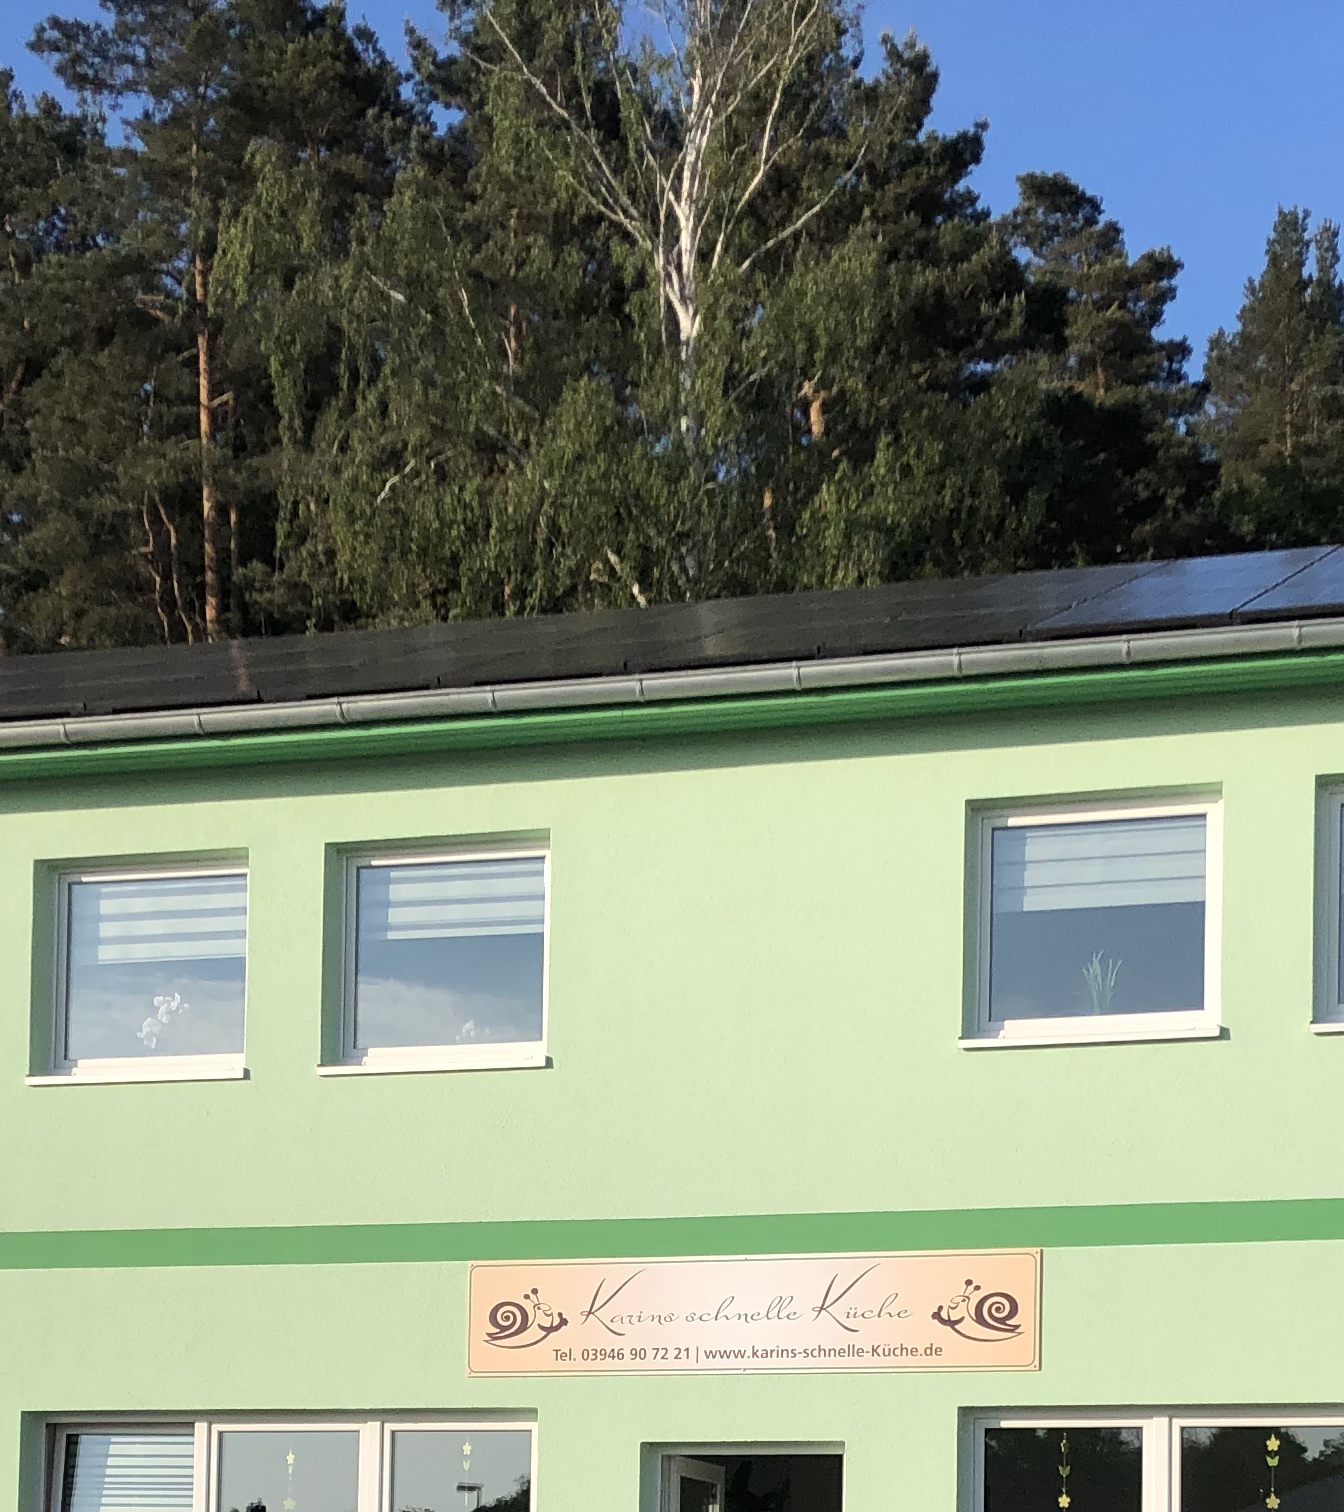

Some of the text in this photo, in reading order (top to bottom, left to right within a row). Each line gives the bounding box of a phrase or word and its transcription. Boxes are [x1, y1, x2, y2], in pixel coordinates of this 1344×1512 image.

[579, 1262, 913, 1337] Karins schnelle Küche
[552, 1347, 577, 1362] Tel.
[581, 1347, 626, 1362] 03946
[629, 1347, 648, 1361] 90
[652, 1346, 669, 1361] 72
[673, 1346, 691, 1361] 21
[703, 1342, 944, 1361] www.karins-schnelle-Küche.de
